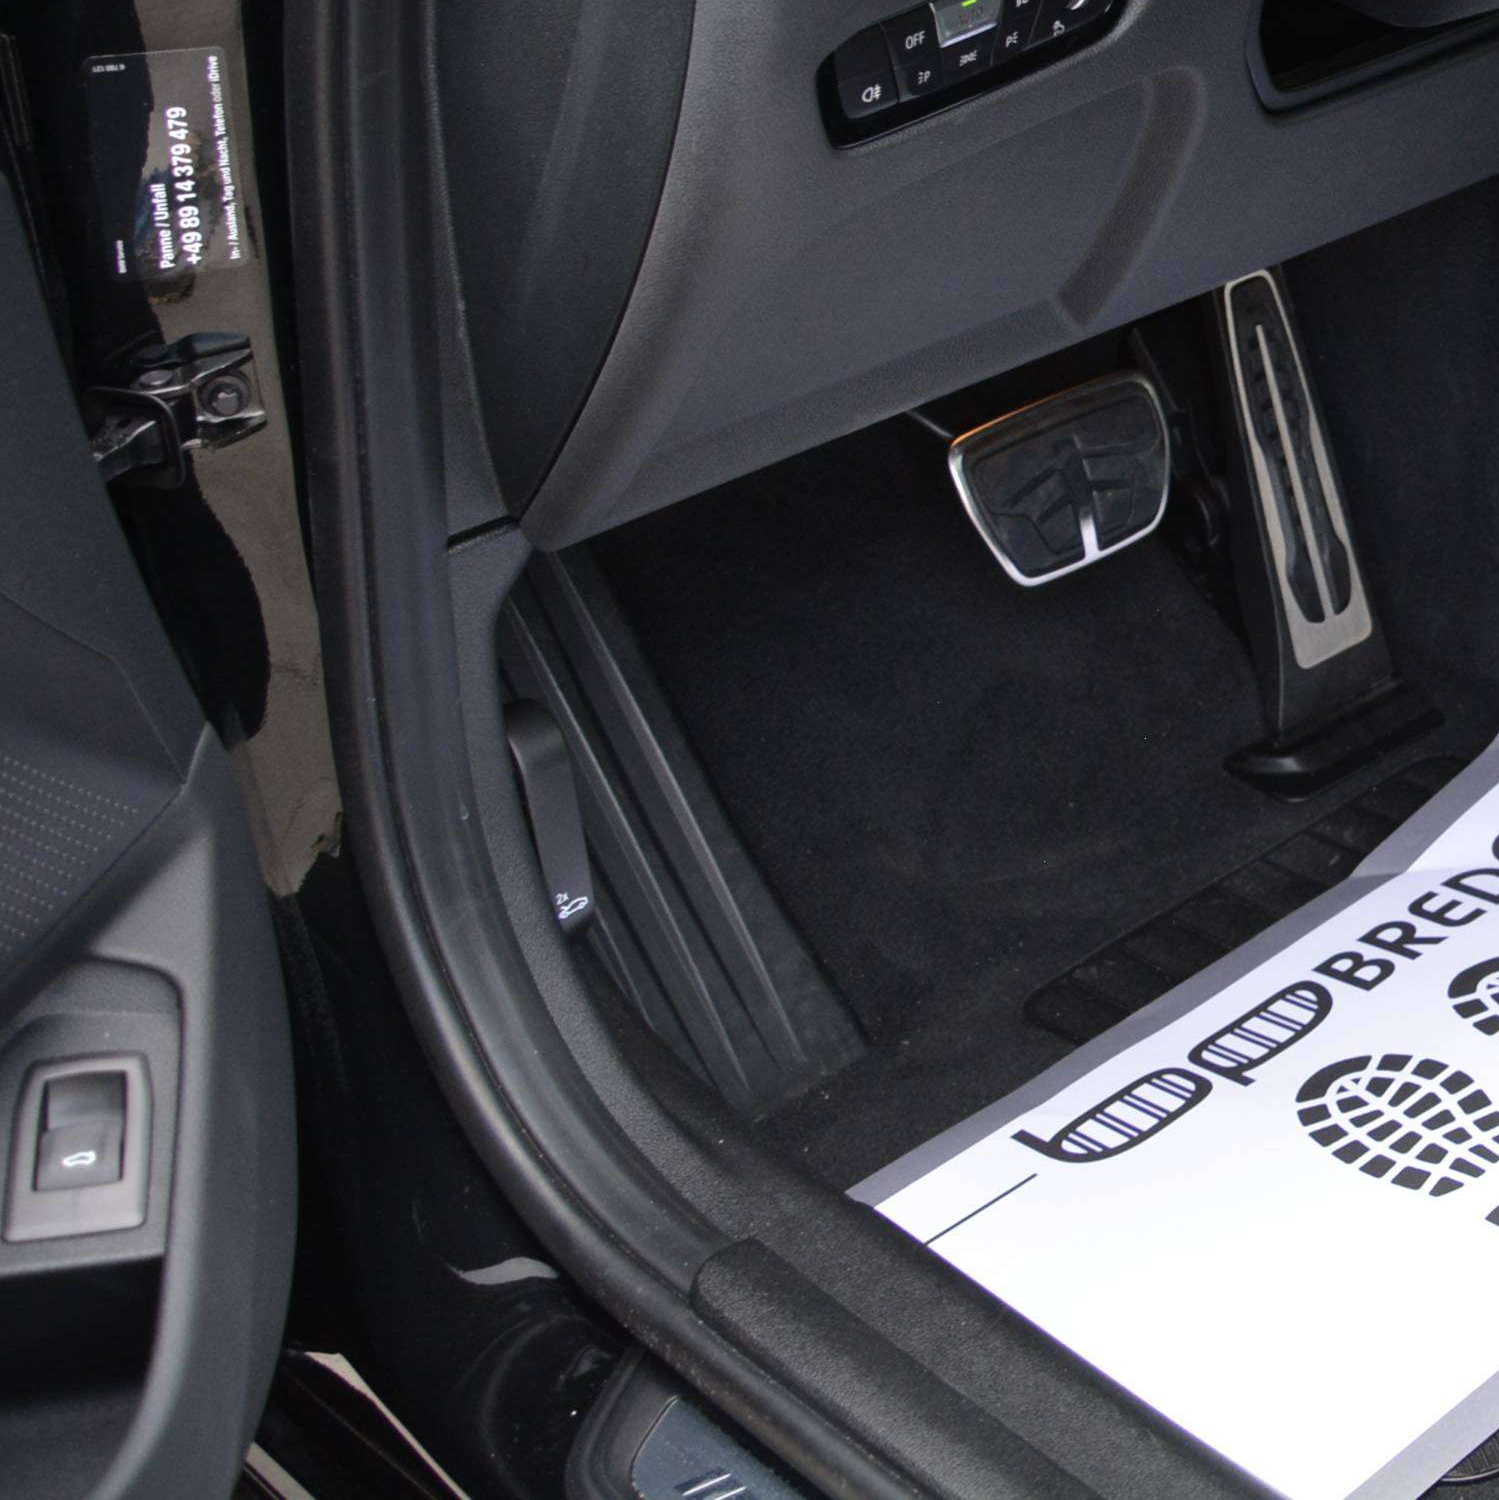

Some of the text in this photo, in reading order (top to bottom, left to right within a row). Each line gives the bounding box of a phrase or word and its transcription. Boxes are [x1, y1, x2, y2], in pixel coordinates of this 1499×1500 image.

[905, 30, 926, 50] OFF
[166, 106, 203, 265] +49 89 14 379 479
[219, 166, 232, 185] und
[150, 183, 169, 221] Unfall
[159, 229, 176, 269] Panne
